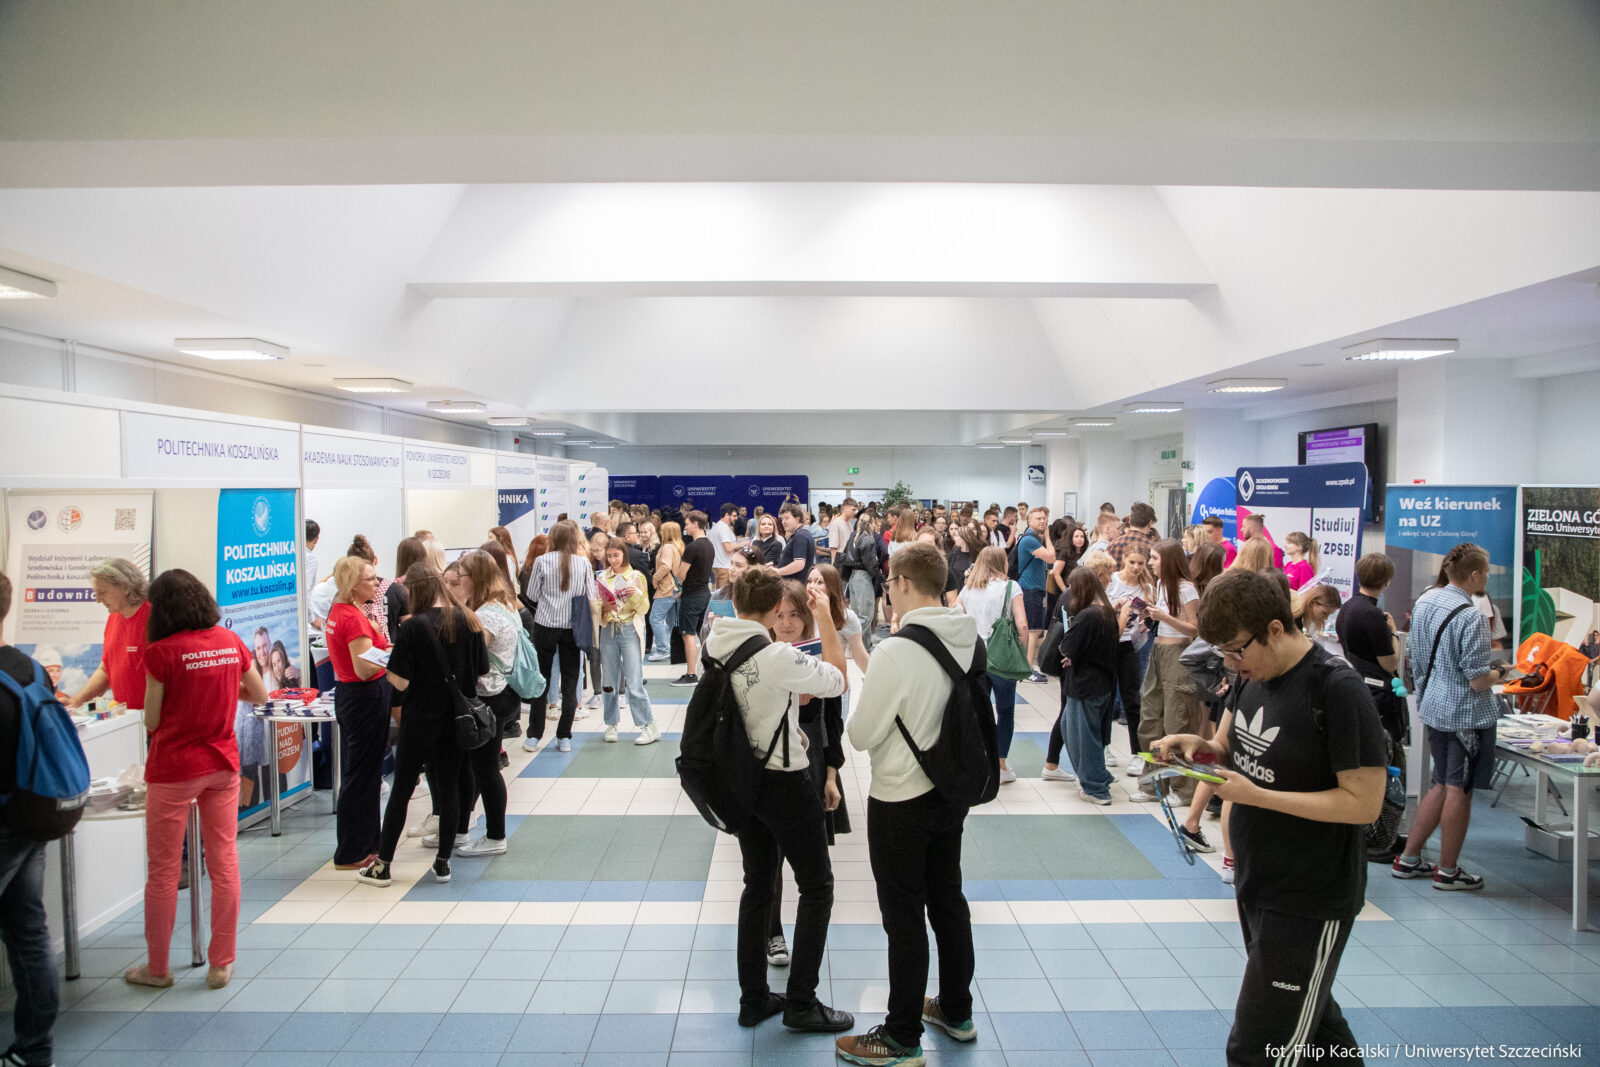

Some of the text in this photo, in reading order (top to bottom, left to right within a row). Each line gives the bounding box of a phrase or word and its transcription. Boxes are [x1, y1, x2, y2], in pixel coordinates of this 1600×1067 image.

[157, 438, 279, 461] POLITECHNIKA KOSZALIŃSKA
[498, 494, 529, 504] HNIKA
[1399, 496, 1502, 511] Weź kierunek
[1399, 515, 1442, 527] na UZ
[1527, 508, 1600, 524] ZIELONA GÓ
[1314, 517, 1355, 536] Studiuj
[1527, 521, 1600, 536] Miasto Uniwersyte
[223, 541, 296, 561] POLITECHNIKA
[1323, 542, 1354, 556] ZPSB!
[225, 560, 297, 584] KOSZALIŃSKA
[1321, 575, 1333, 585] woja
[26, 589, 97, 601] Budownic
[231, 579, 295, 600] www.tu.koszalin.pl
[182, 647, 238, 662] POLITECHNIKA
[185, 656, 240, 671] KOSZALIŃSKA
[276, 723, 299, 738] TUDIUJ
[278, 744, 301, 761] ORZEM
[1233, 751, 1276, 784] adidas
[1271, 981, 1301, 992] adidas
